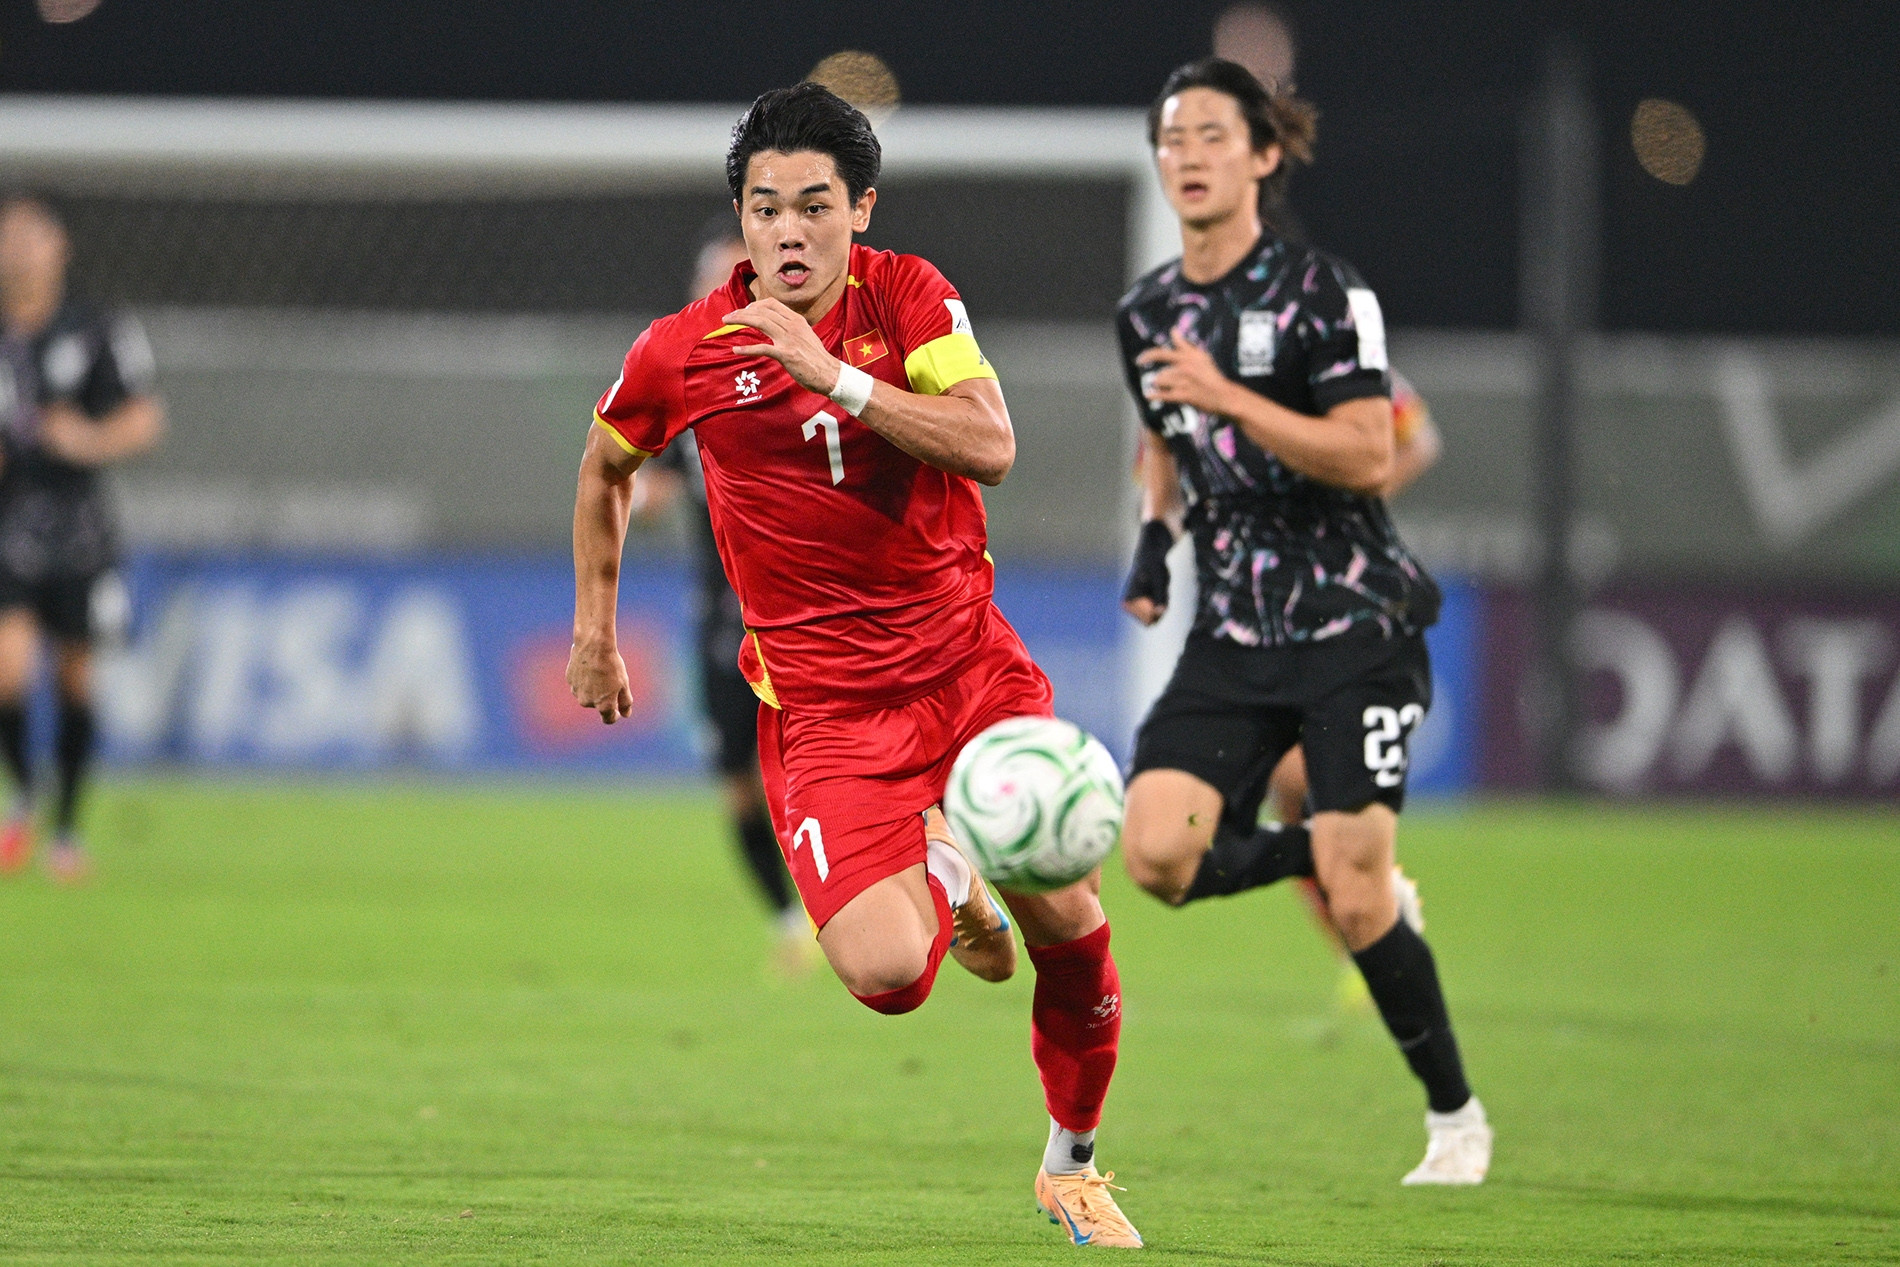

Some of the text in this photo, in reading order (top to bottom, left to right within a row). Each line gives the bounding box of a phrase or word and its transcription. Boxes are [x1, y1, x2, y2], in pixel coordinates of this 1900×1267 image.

[801, 409, 846, 487] 7
[92, 580, 472, 744] VISA
[793, 816, 830, 883] 7
